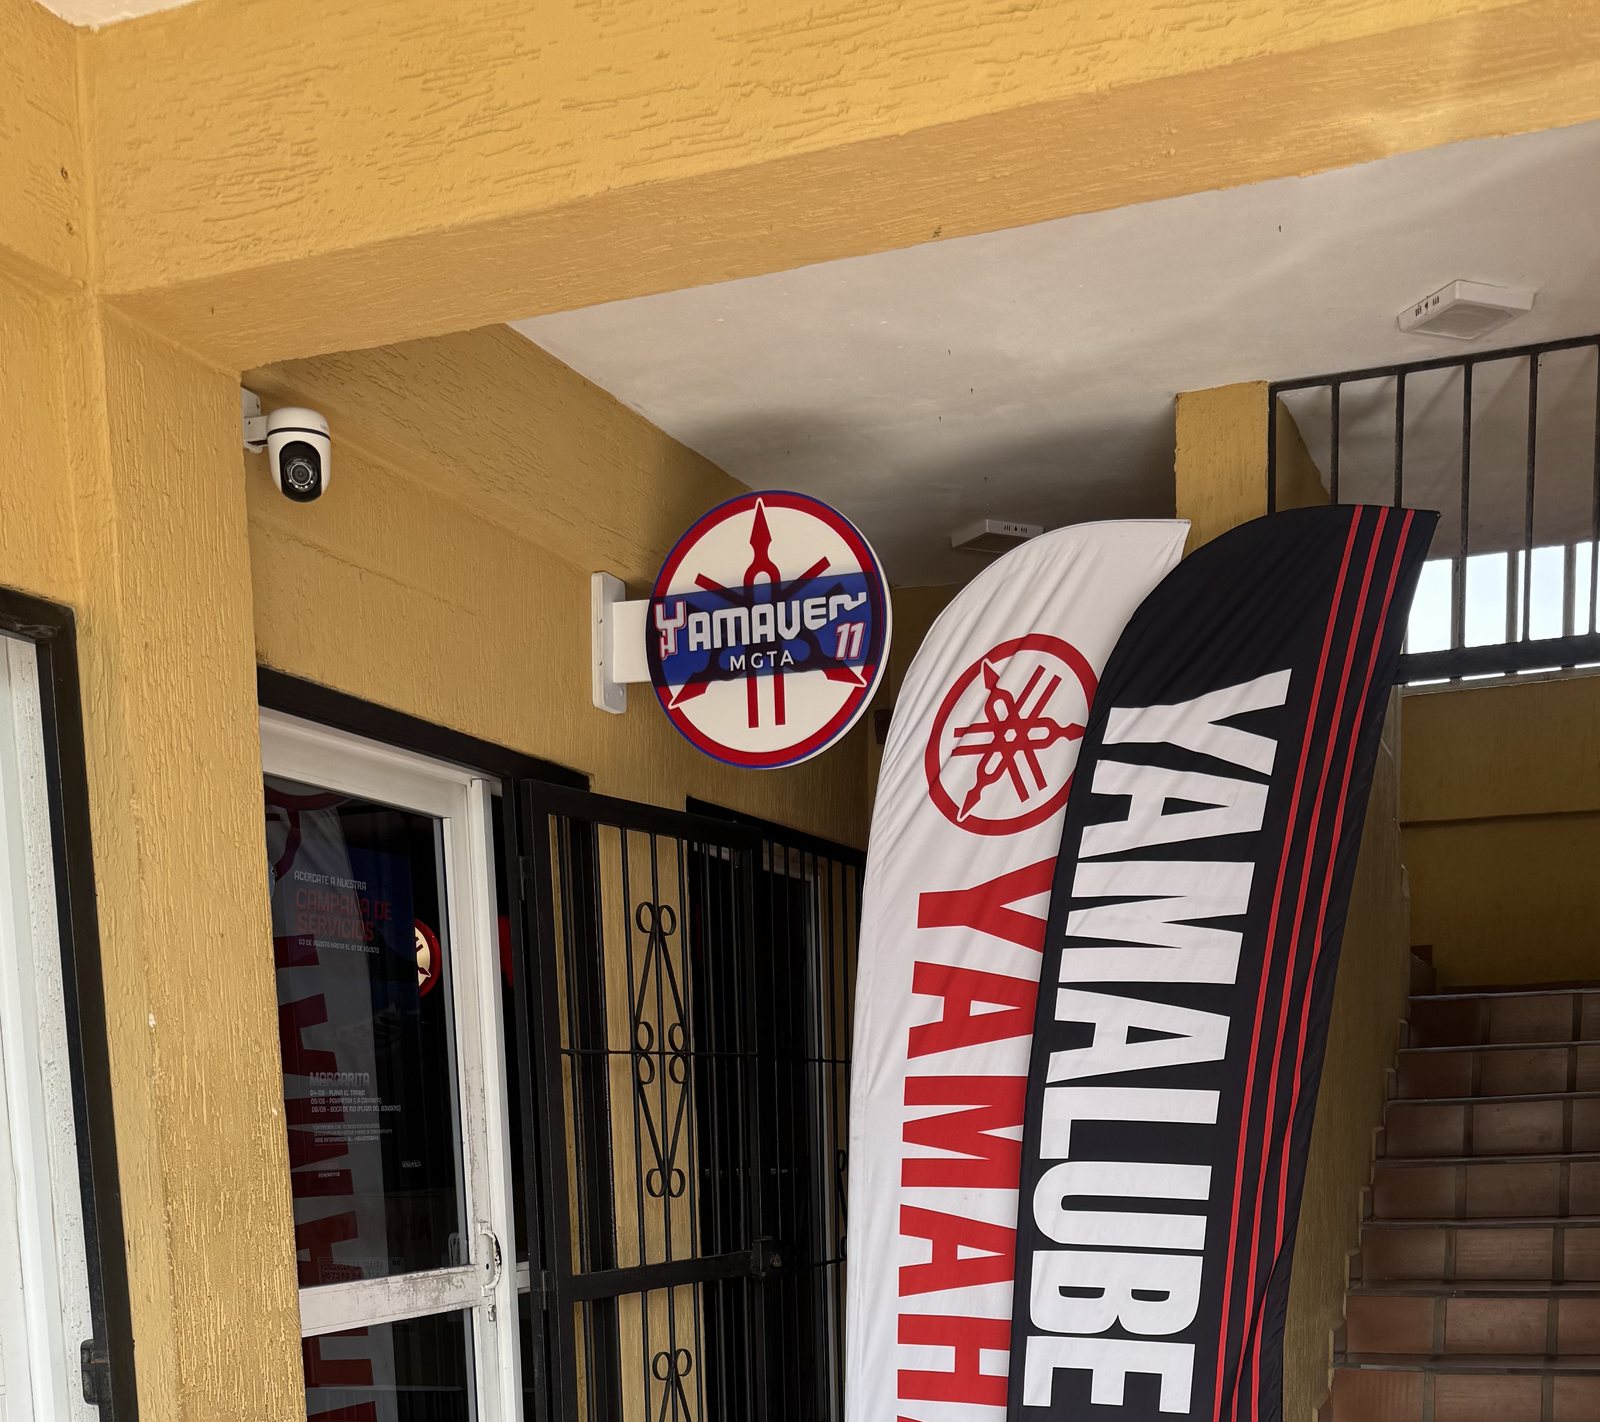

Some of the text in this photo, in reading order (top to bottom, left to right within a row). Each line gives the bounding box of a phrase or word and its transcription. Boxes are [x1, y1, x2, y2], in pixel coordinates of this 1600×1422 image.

[654, 591, 867, 661] YAMAVEN
[835, 622, 865, 661] 11
[729, 650, 795, 672] MGTA
[337, 879, 367, 891] NUESTRA
[374, 900, 393, 921] DE
[296, 912, 375, 943] SERVICIOS
[1022, 667, 1293, 1415] YAMALUBE
[309, 1072, 370, 1087] MARGARITA
